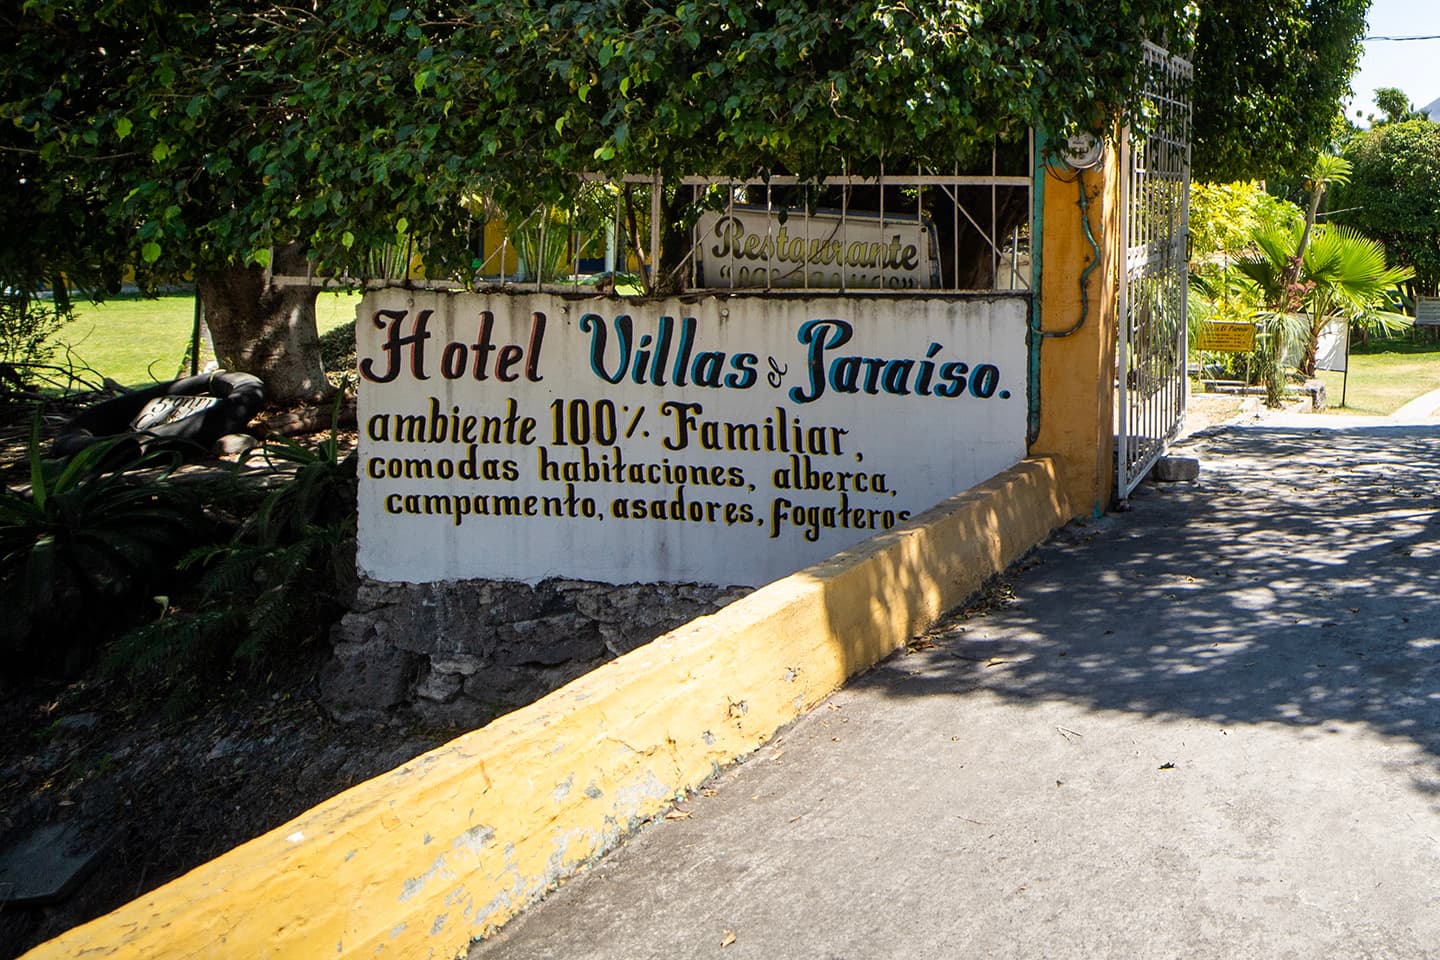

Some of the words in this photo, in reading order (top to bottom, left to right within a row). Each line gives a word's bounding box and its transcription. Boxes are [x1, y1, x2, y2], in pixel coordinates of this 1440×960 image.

[712, 215, 920, 271] Restaurante
[359, 309, 547, 384] Hotel
[580, 313, 759, 389] Villas
[788, 319, 1012, 404] Paraíso.
[366, 396, 537, 446] ambiente
[366, 444, 520, 482] comodas
[537, 446, 756, 494] habitaciones,
[772, 454, 897, 497] alberca,
[384, 483, 604, 527] campamento,
[610, 485, 764, 527] asadores,
